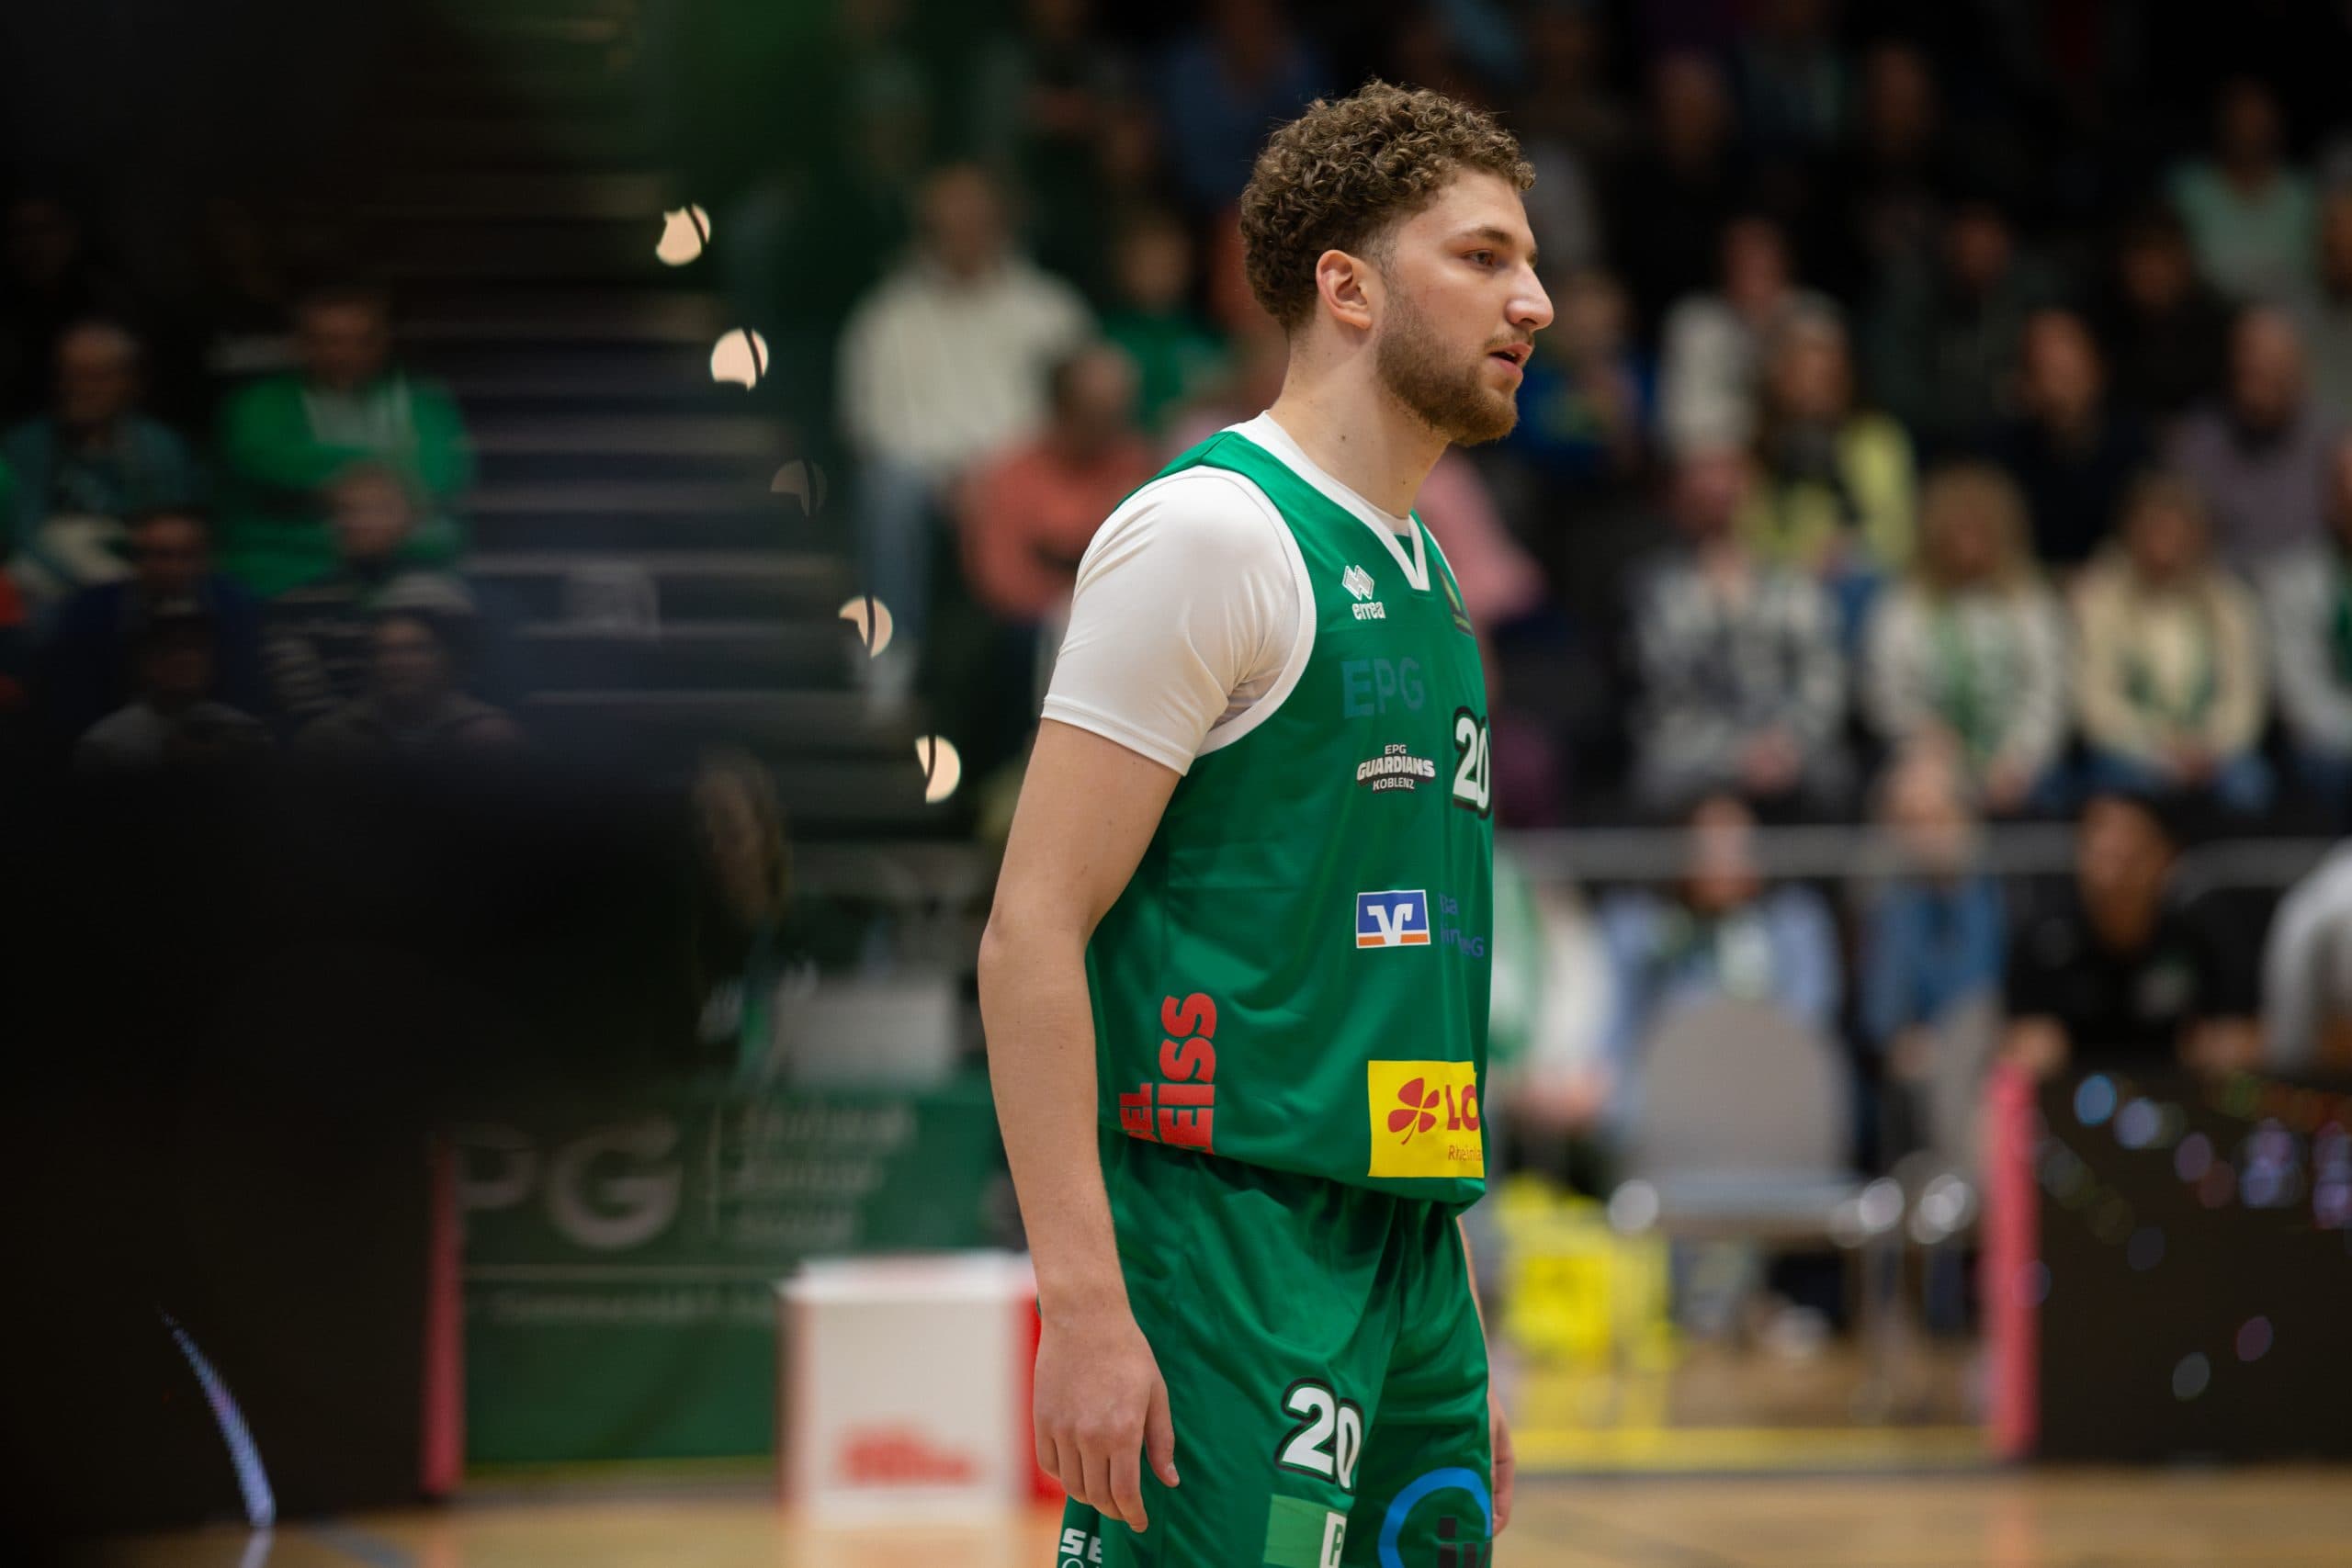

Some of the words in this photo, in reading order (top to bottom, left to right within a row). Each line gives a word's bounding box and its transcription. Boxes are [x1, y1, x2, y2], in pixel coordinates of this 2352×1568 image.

[1340, 656, 1424, 719] EPG
[1356, 755, 1436, 782] GUARDIANS
[1385, 744, 1408, 755] EPG
[1452, 712, 1490, 812] 20
[1373, 779, 1416, 792] KOBLENZ
[1158, 992, 1217, 1156] EISS
[1119, 1083, 1159, 1143] EL
[1277, 1382, 1363, 1493] 20
